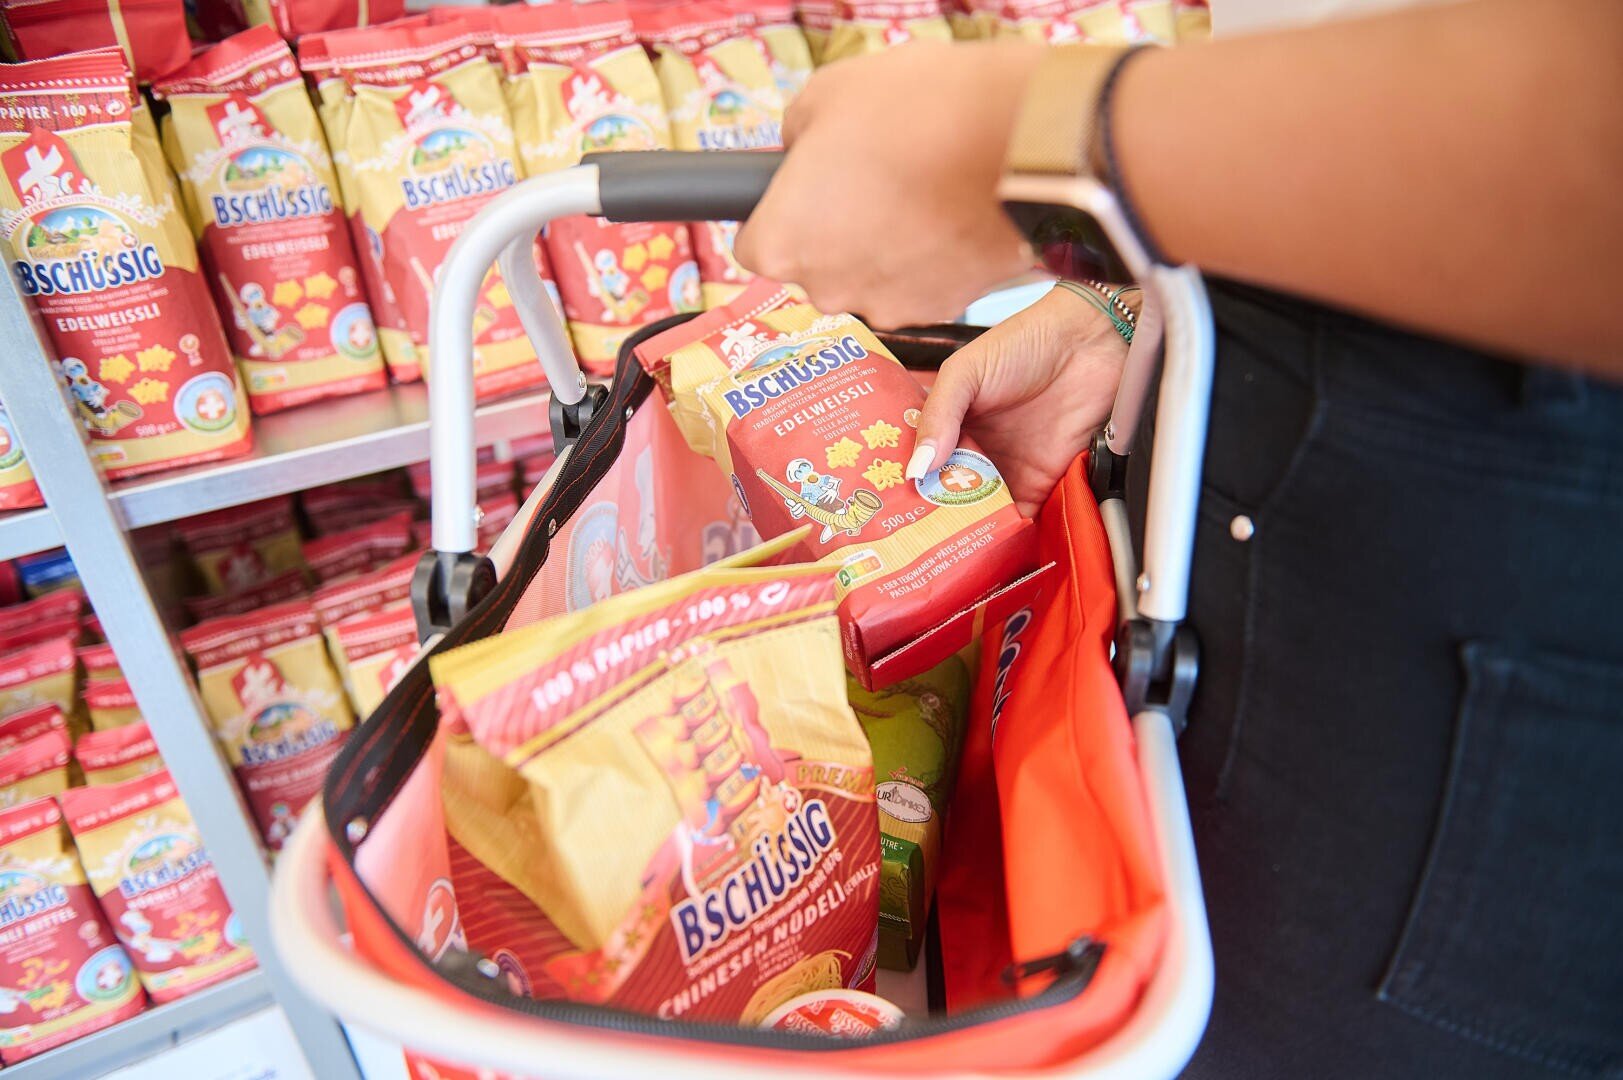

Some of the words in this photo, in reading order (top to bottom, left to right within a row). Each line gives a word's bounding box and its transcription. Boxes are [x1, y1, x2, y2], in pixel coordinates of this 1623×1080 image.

[0, 105, 50, 119] PAPIER
[61, 104, 87, 118] 100
[89, 103, 102, 115] %
[15, 246, 163, 295] BSCHÜSSIG
[57, 302, 161, 332] EDELWEISSLI
[724, 336, 867, 419] BSCHÜSSIG
[752, 408, 790, 431] TRADIZIONE
[788, 392, 817, 412] SVIZZERA
[818, 375, 858, 399] TRADITIONAL
[857, 366, 878, 380] SWISS
[761, 392, 805, 416] URSCHWEIZER
[805, 377, 838, 395] TRADITION
[773, 381, 875, 437] EDELWEISSLI
[813, 405, 850, 427] EDELWEISS
[813, 420, 838, 437] STELLE
[835, 410, 862, 428] ALPINE
[824, 420, 861, 441] EDELWEISS
[881, 514, 906, 533] 500
[905, 511, 917, 523] g
[889, 584, 912, 600] PASTA
[910, 578, 929, 592] ALLE
[931, 561, 952, 577] UOVA
[953, 547, 975, 565] 3-EGG
[971, 533, 995, 552] PASTA
[899, 558, 936, 585] TEIGWAREN
[956, 534, 973, 548] AUX
[531, 671, 573, 712] 100
[571, 660, 596, 683] %
[592, 618, 670, 673] PAPIER
[687, 596, 727, 624] 100
[731, 592, 751, 610] %
[677, 801, 833, 960] BSCHÜSSIG
[658, 937, 769, 1020] CHINESEN
